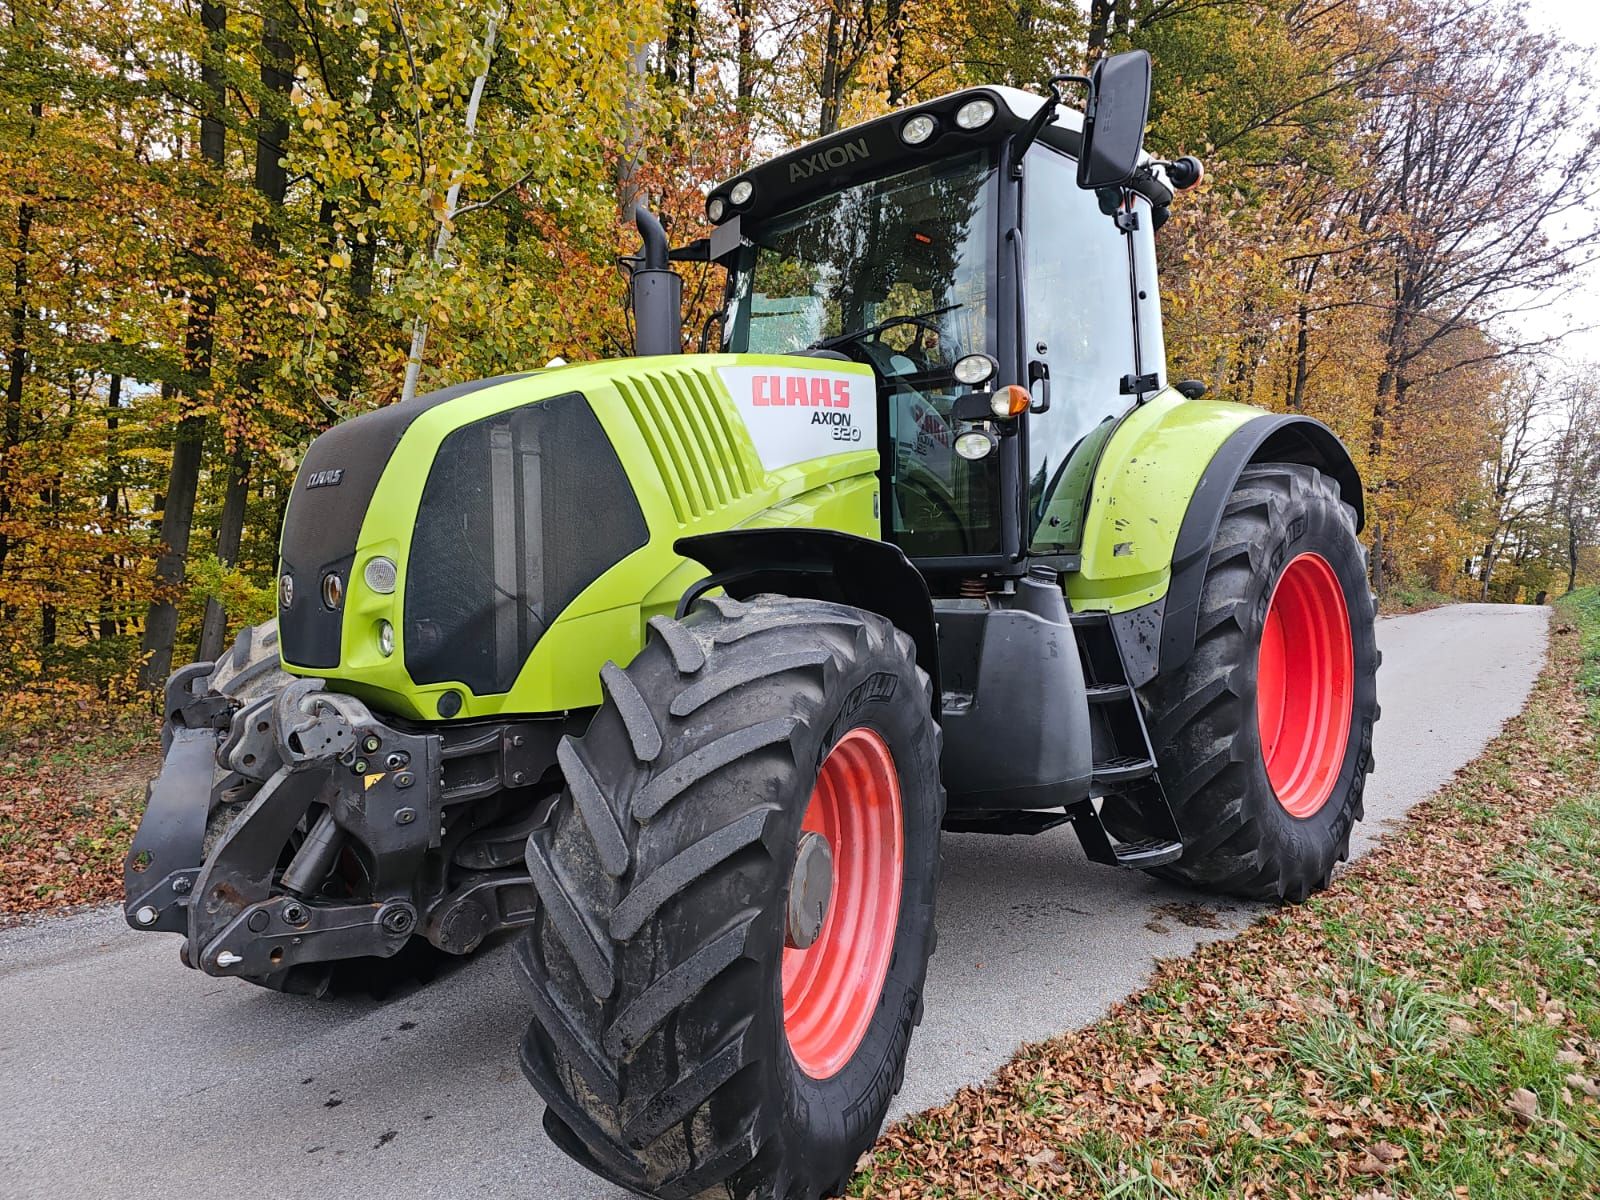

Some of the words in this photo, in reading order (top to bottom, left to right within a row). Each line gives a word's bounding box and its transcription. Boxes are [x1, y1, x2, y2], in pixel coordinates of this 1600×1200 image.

[789, 138, 870, 183] AXION
[752, 376, 850, 408] CLAAS
[811, 411, 851, 426] AXION
[831, 426, 861, 441] 820
[306, 469, 344, 488] CLAAS
